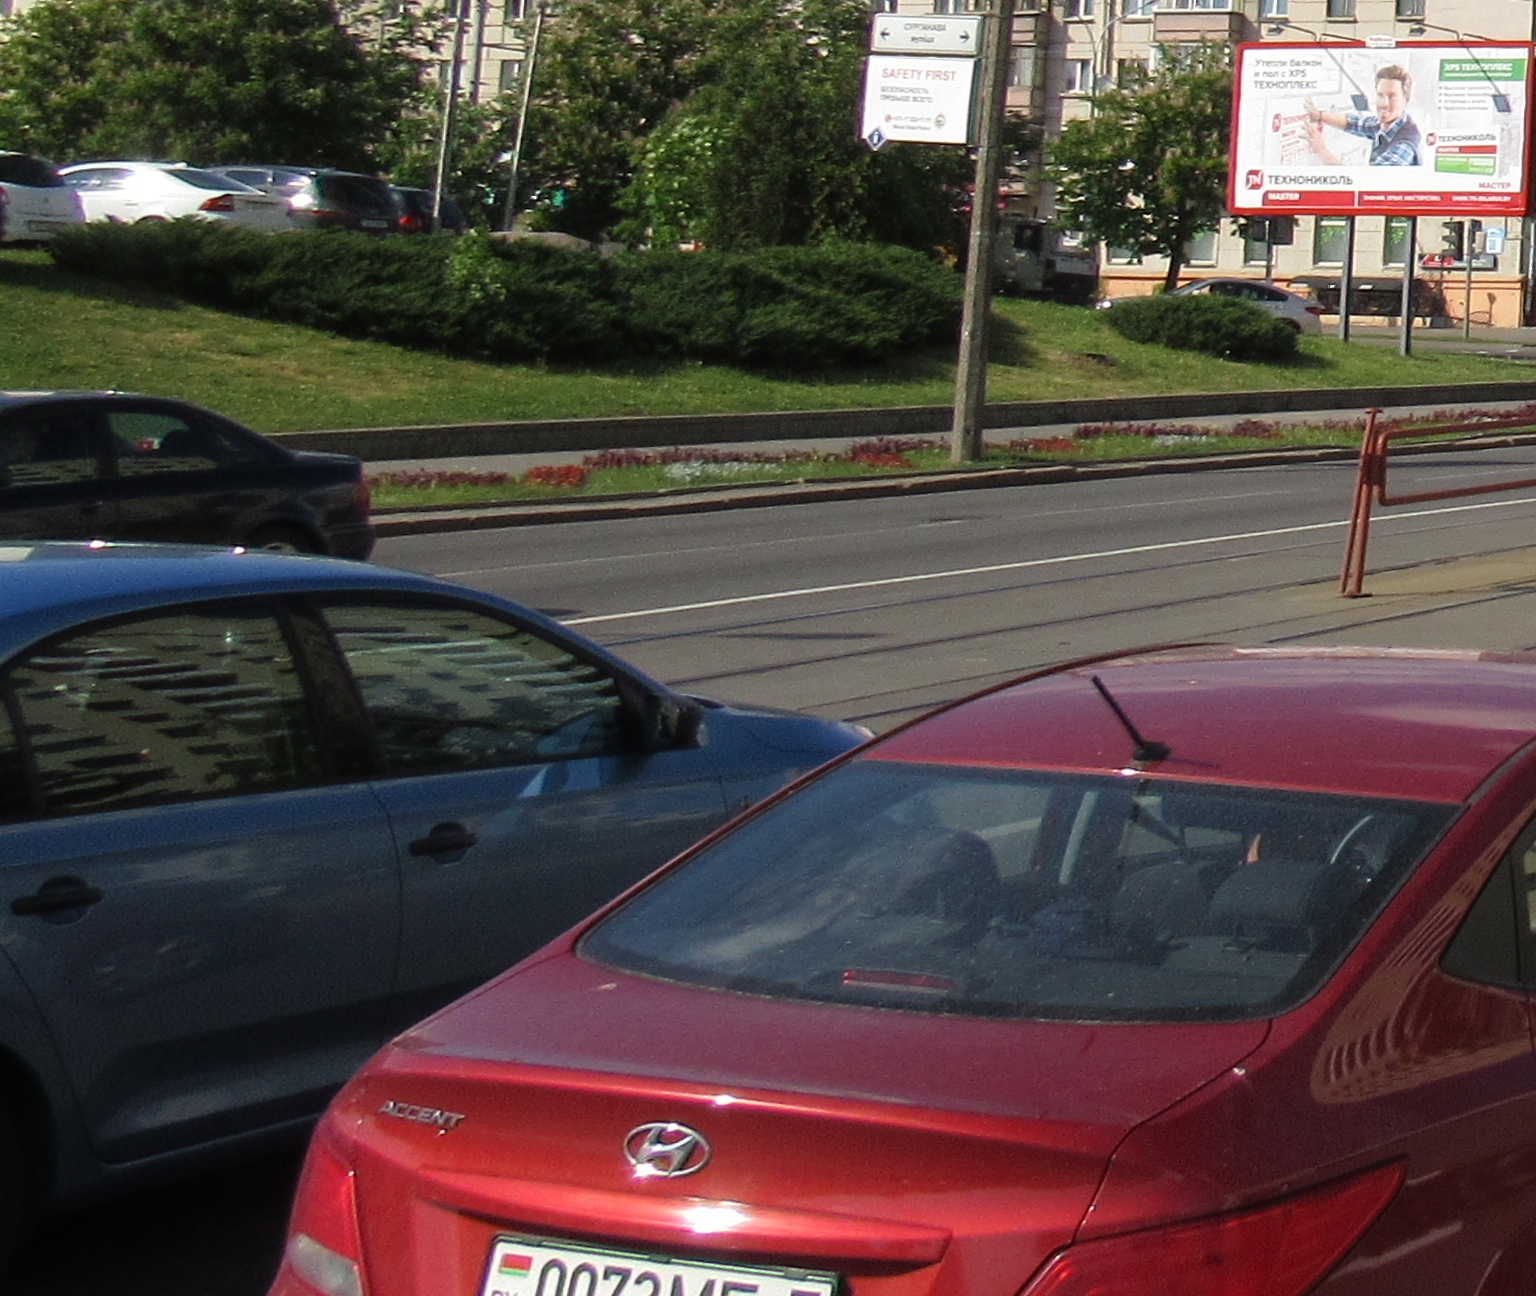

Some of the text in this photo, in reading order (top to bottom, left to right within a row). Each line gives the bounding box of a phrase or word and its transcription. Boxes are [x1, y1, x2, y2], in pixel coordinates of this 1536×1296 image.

[881, 68, 958, 82] SAFETY FIRST
[1253, 80, 1319, 90] ТЕХНОПЛЕКС
[1267, 174, 1354, 185] ТЕХНОНИКОЛЬ
[378, 1099, 466, 1129] ACCENT
